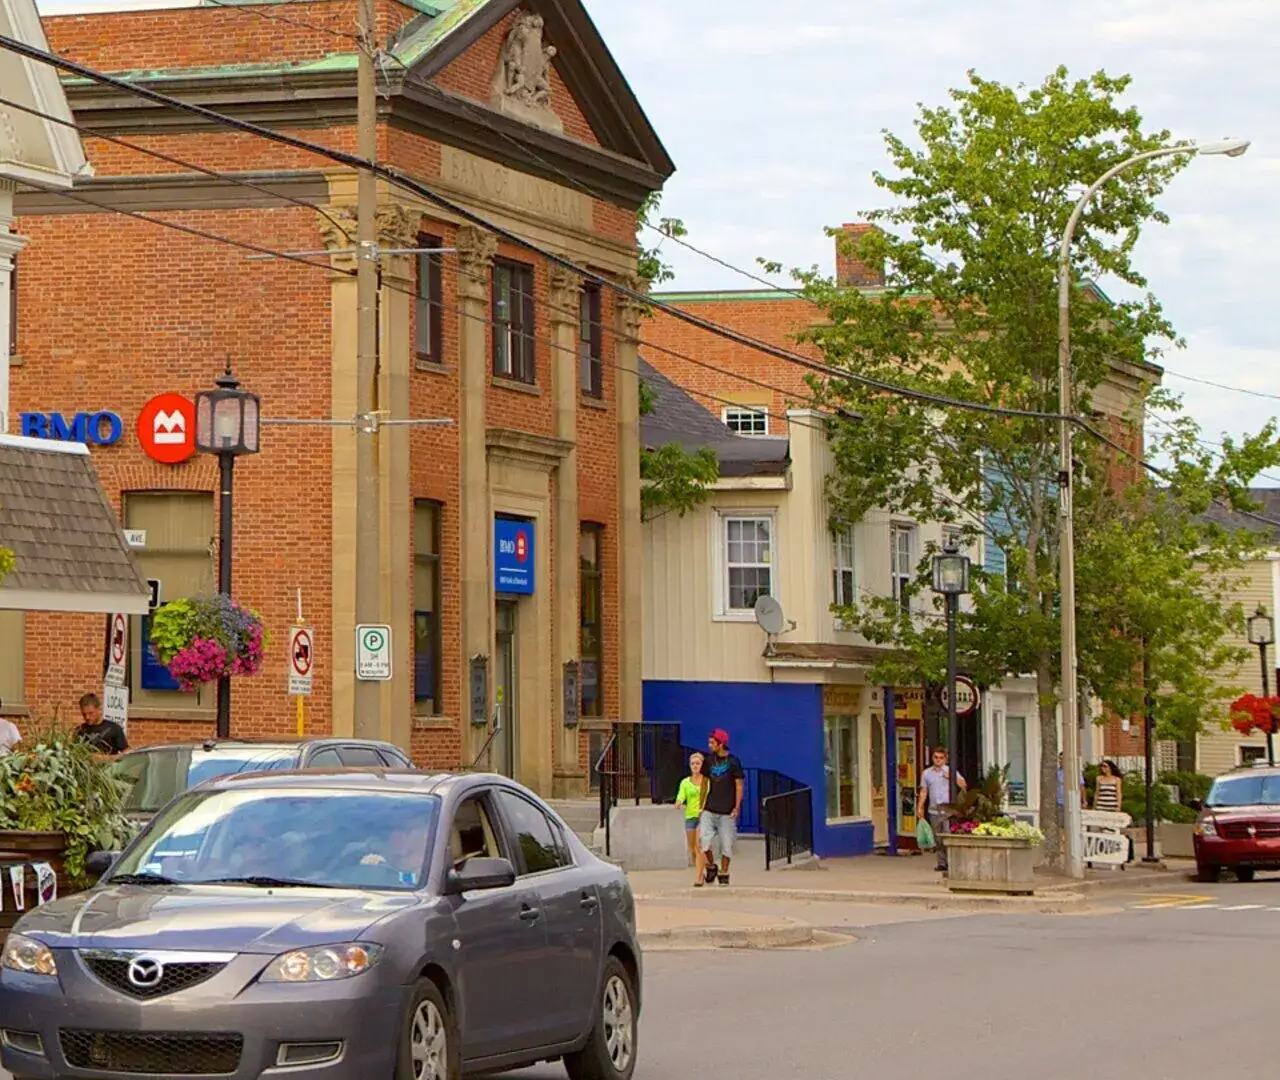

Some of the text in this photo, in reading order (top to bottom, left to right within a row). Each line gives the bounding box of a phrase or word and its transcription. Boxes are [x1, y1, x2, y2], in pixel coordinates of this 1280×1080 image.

[20, 410, 123, 445] BMO
[369, 635, 378, 647] P
[107, 695, 125, 711] LOCAL
